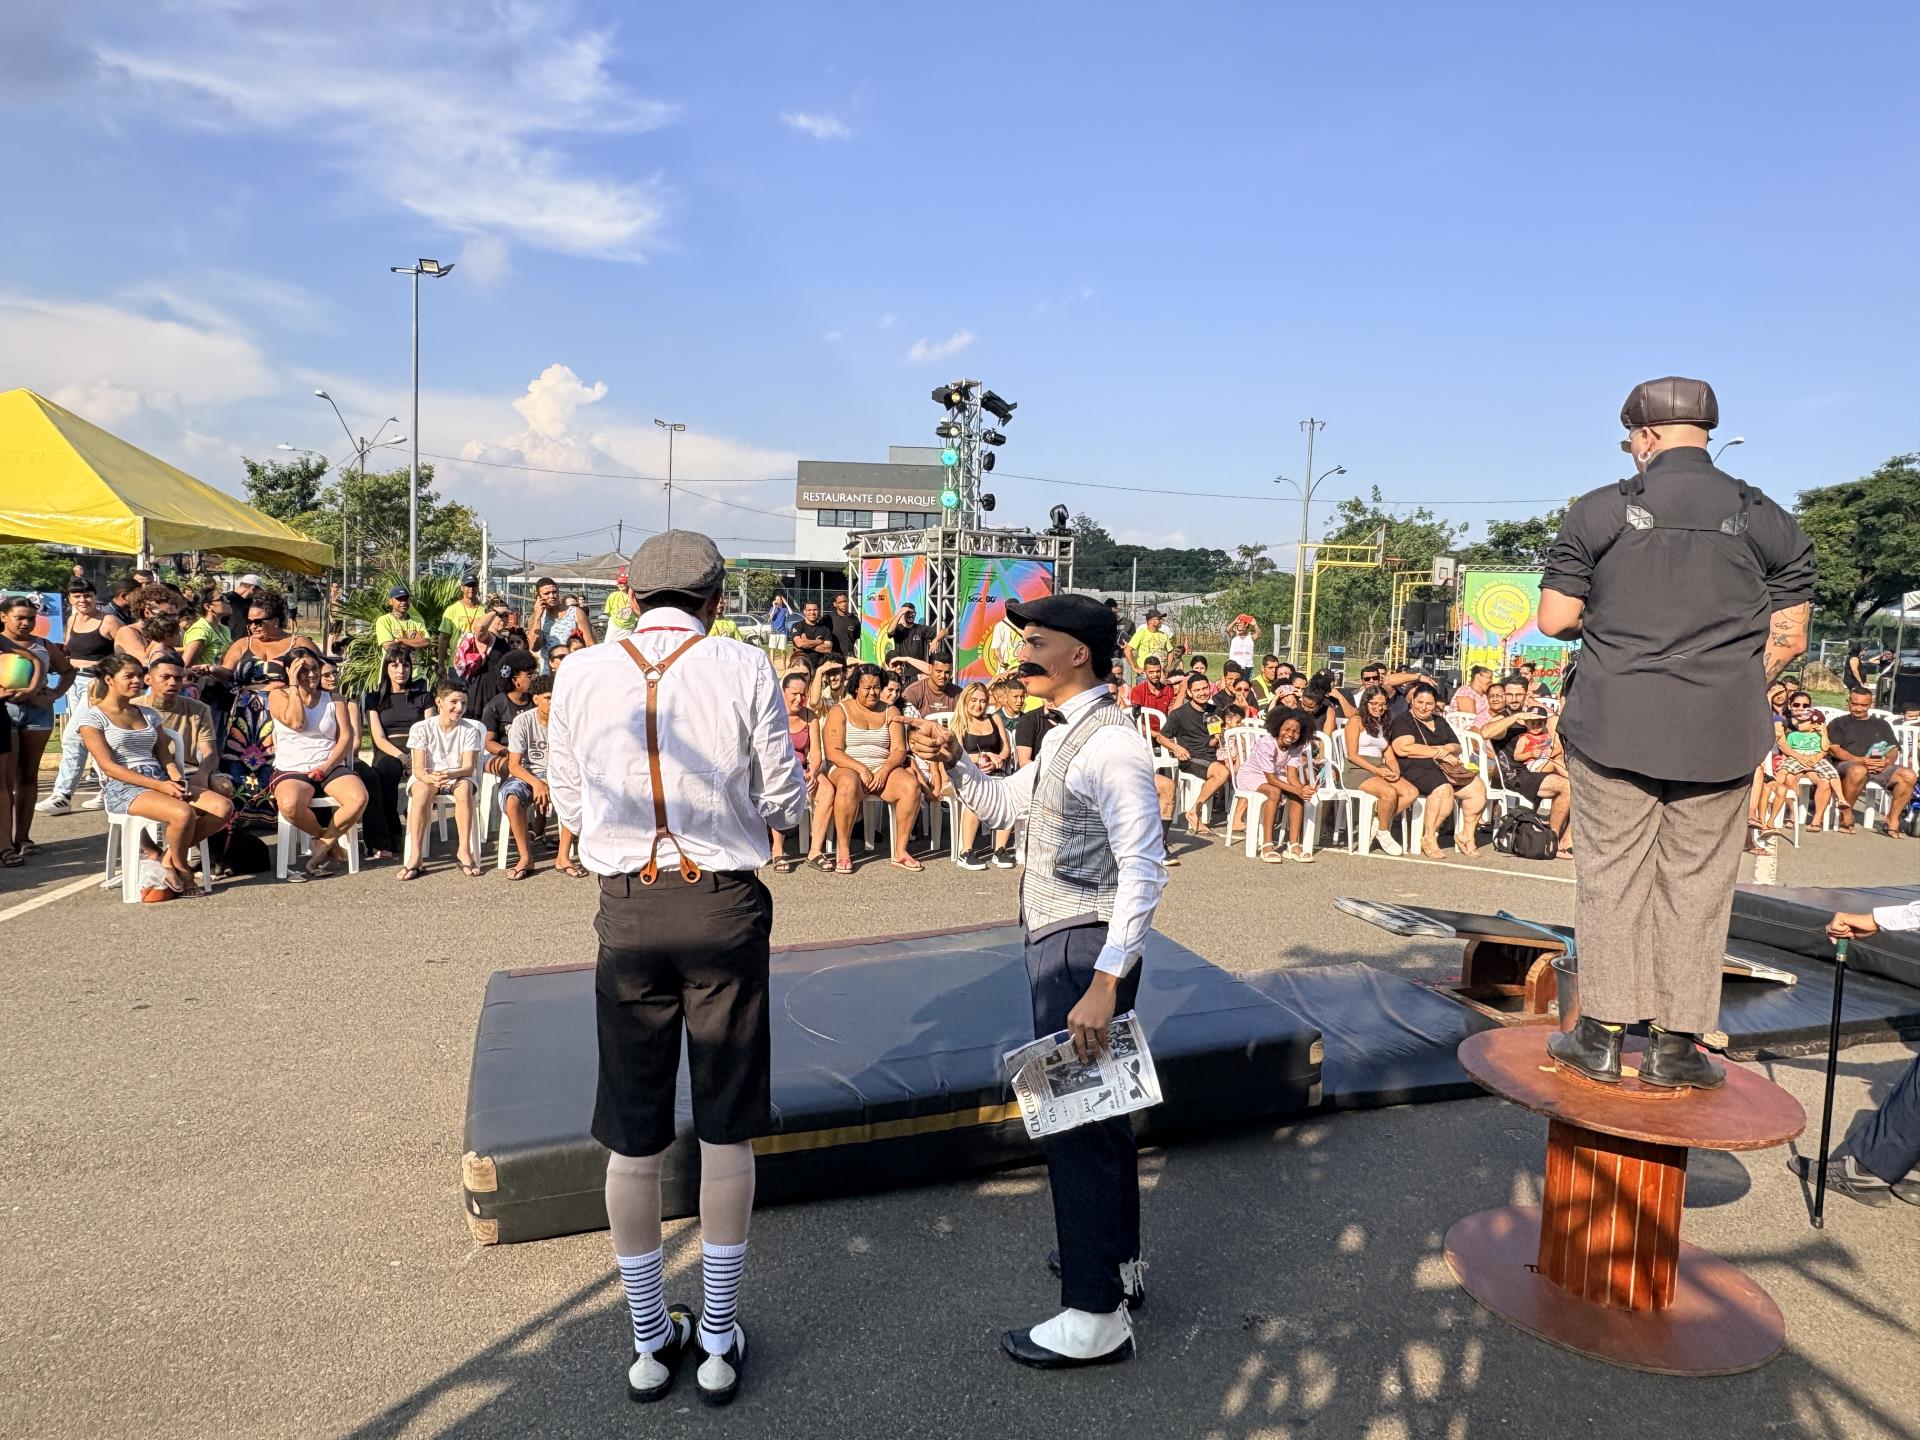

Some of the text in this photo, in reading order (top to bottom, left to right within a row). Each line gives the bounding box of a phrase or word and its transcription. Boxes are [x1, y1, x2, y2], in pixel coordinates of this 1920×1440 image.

[803, 492, 937, 507] RESTAURANTE DO PARQUE
